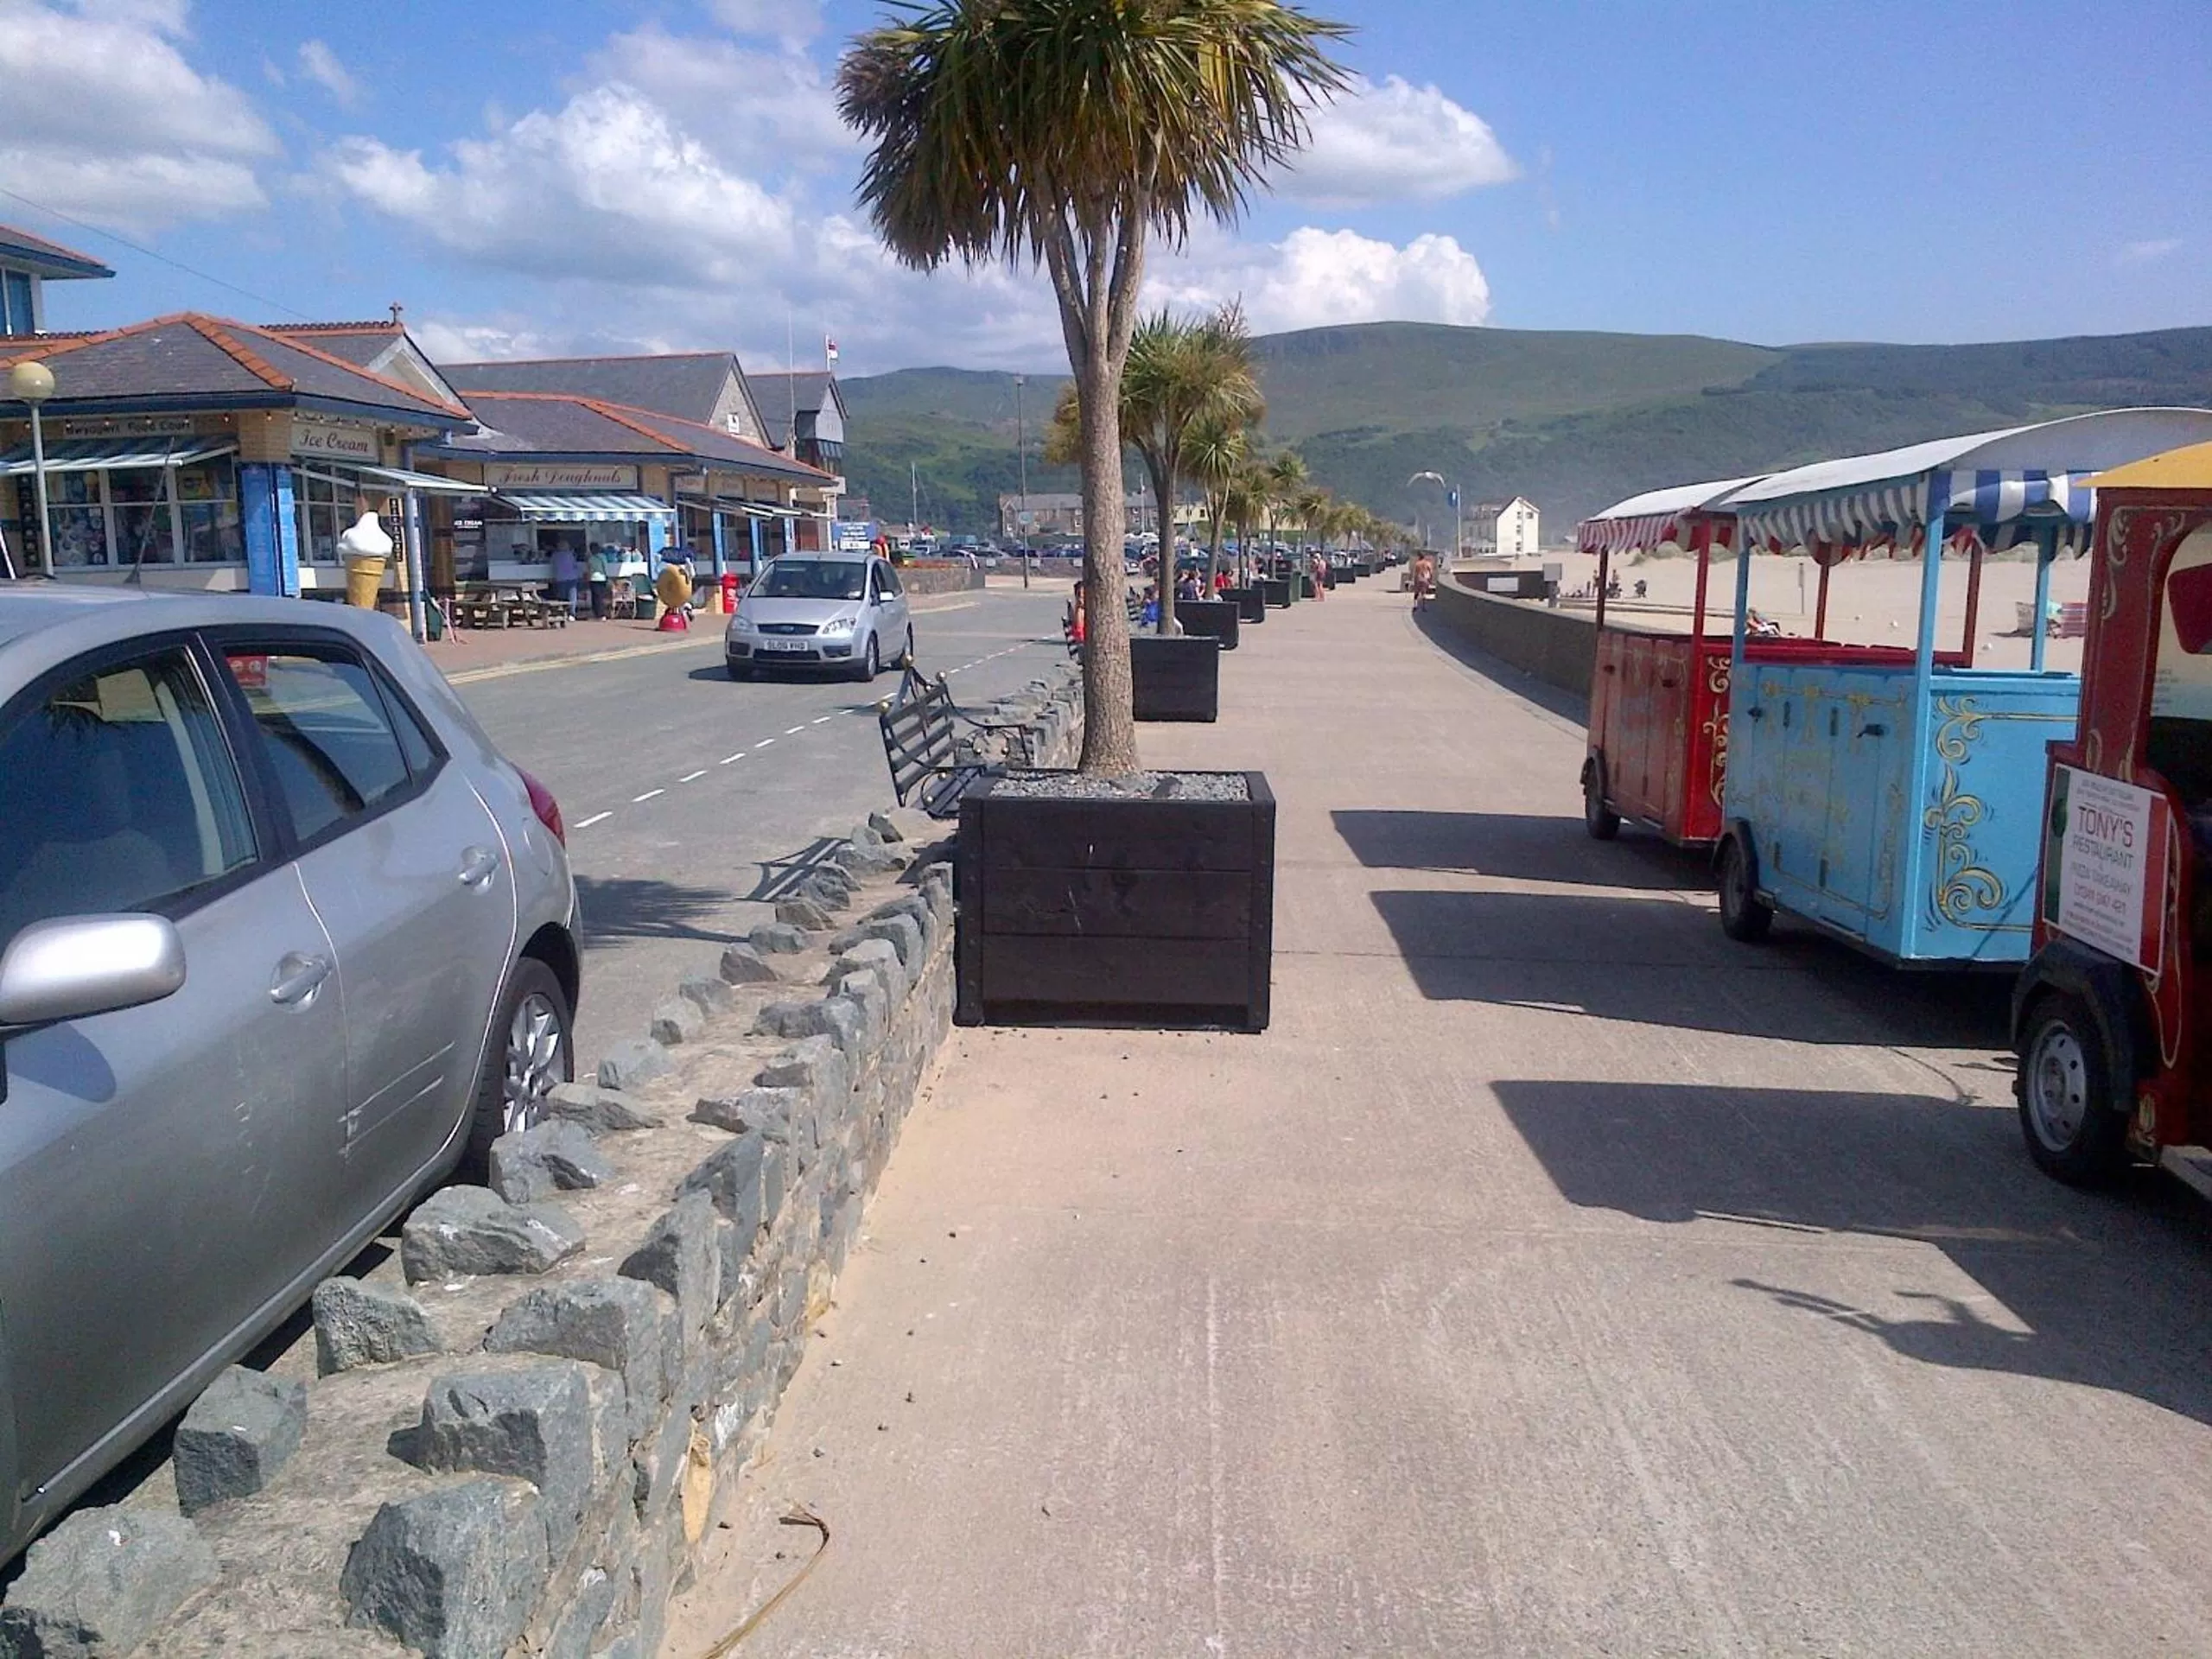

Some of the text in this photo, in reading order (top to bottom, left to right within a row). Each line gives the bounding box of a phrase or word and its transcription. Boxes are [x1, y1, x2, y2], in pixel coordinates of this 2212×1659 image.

[299, 429, 368, 452] Ice Cream
[499, 467, 621, 486] Fresh Doughnuts
[2077, 804, 2134, 849] TONY'S
[2073, 834, 2135, 871] RESTAURANT
